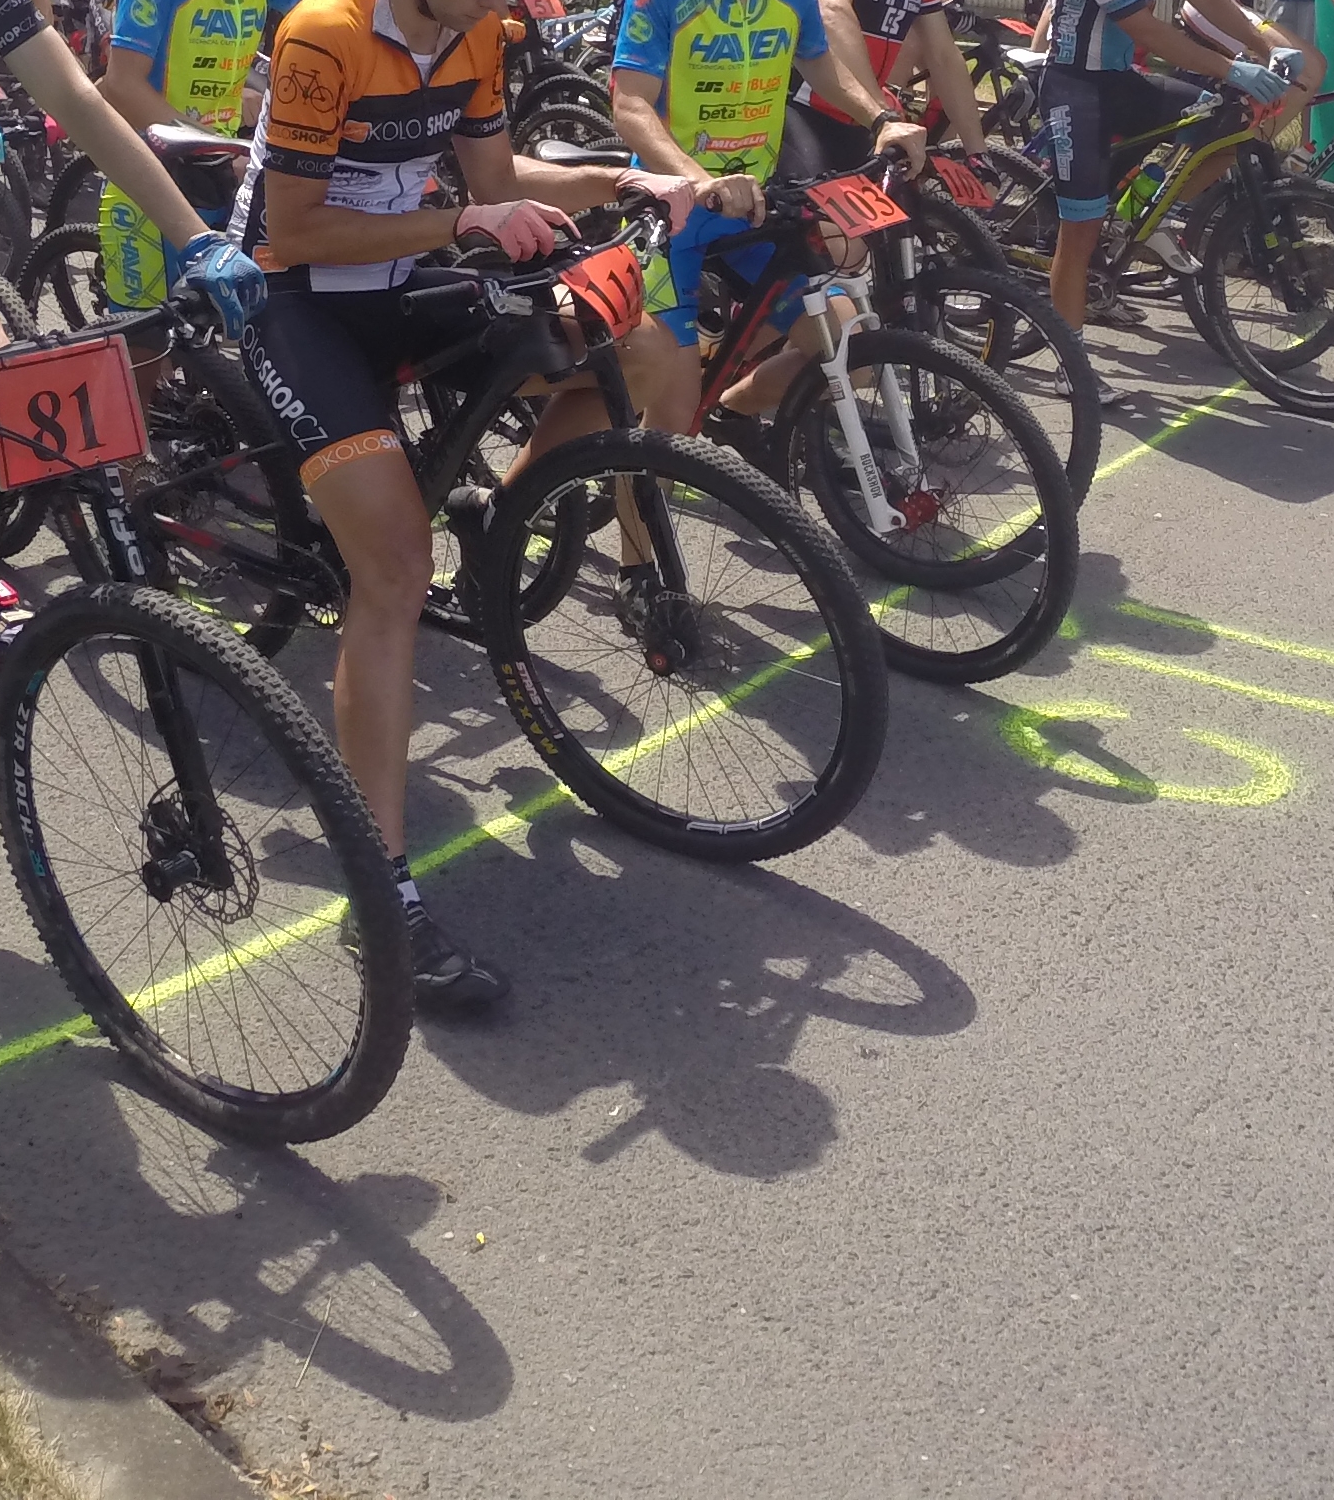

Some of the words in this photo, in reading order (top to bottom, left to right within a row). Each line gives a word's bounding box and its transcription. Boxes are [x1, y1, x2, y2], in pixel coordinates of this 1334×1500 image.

[688, 27, 793, 63] HAVEN
[367, 119, 422, 142] KOLO
[426, 107, 463, 137] SHOP
[823, 186, 895, 232] 103
[584, 262, 643, 328] 111
[26, 380, 109, 462] 81
[13, 702, 31, 753] ZTR
[501, 663, 559, 756] MAXXIS
